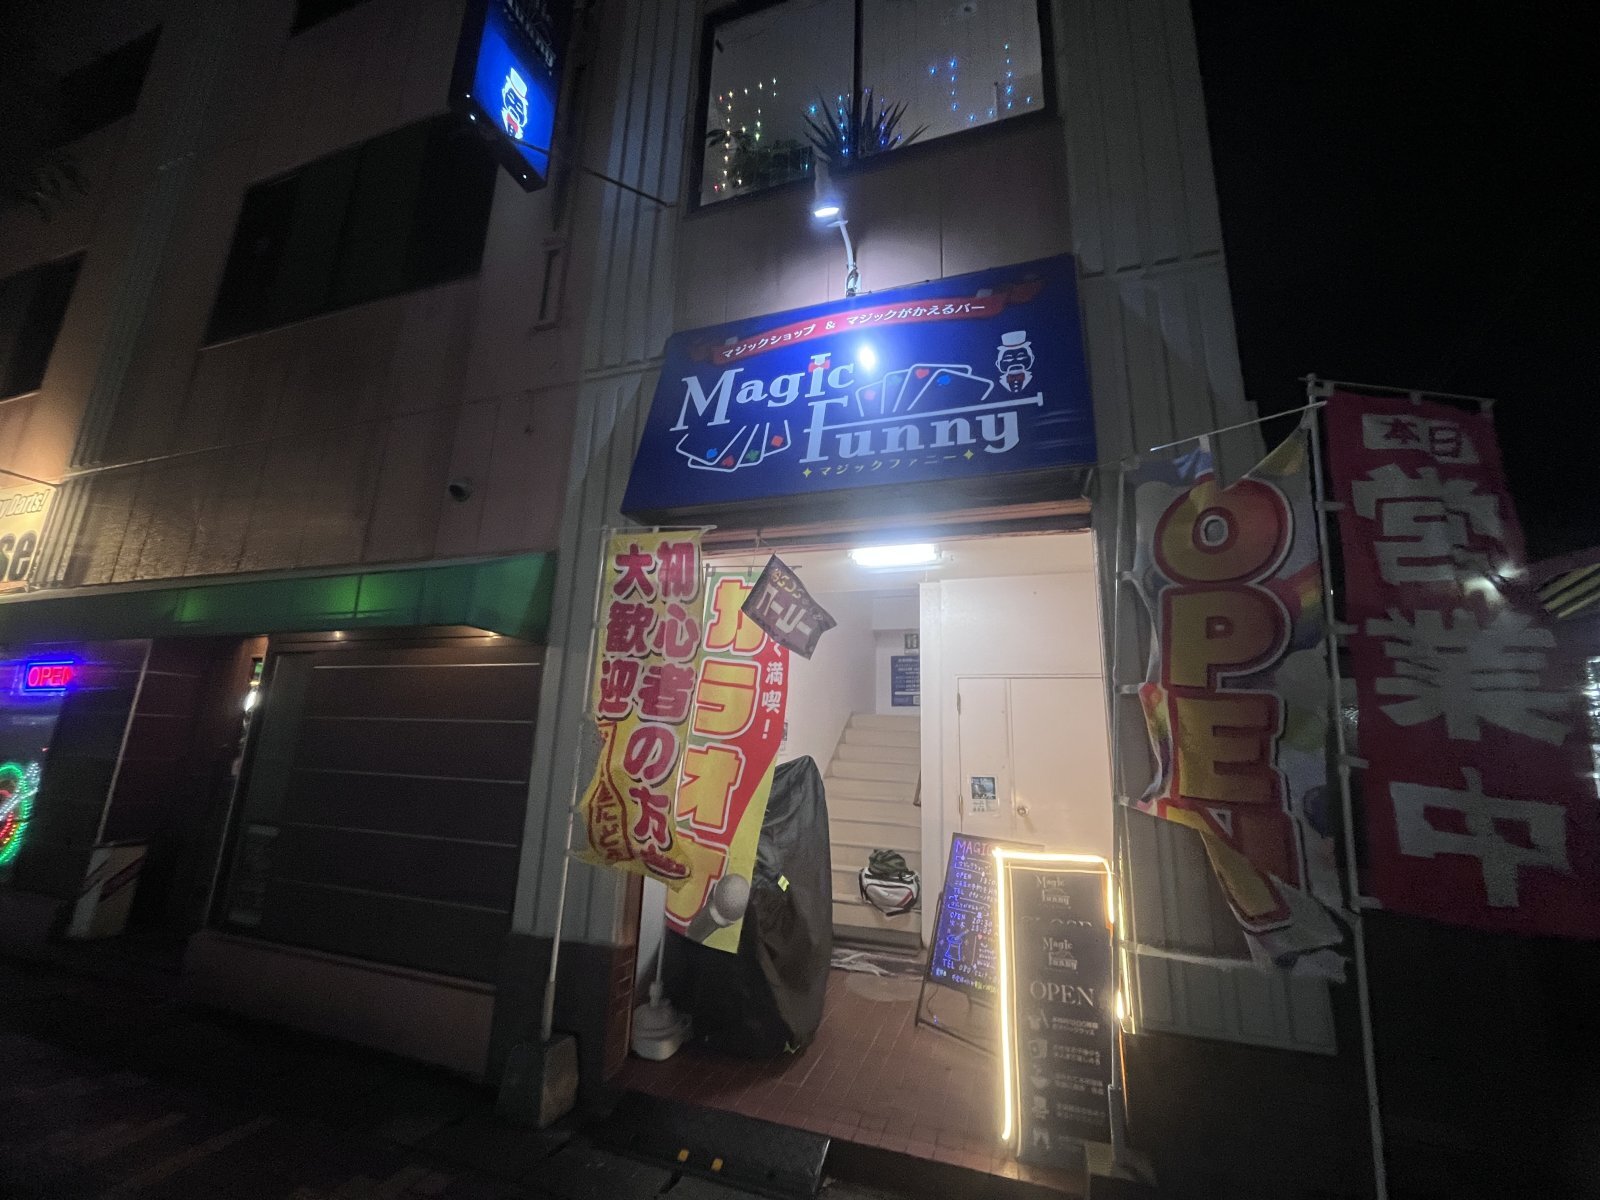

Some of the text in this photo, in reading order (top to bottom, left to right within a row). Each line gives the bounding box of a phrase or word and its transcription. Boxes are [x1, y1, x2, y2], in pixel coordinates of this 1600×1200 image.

[722, 302, 986, 359] マジックショップ & マジックがかえるバー
[669, 352, 855, 434] Magic
[798, 393, 1043, 464] Funny
[1382, 418, 1463, 458] 本日
[820, 454, 958, 476] マジックファニー
[598, 543, 656, 717] 大歓迎
[1352, 460, 1572, 908] 営業中
[1029, 980, 1095, 1008] OPEN
